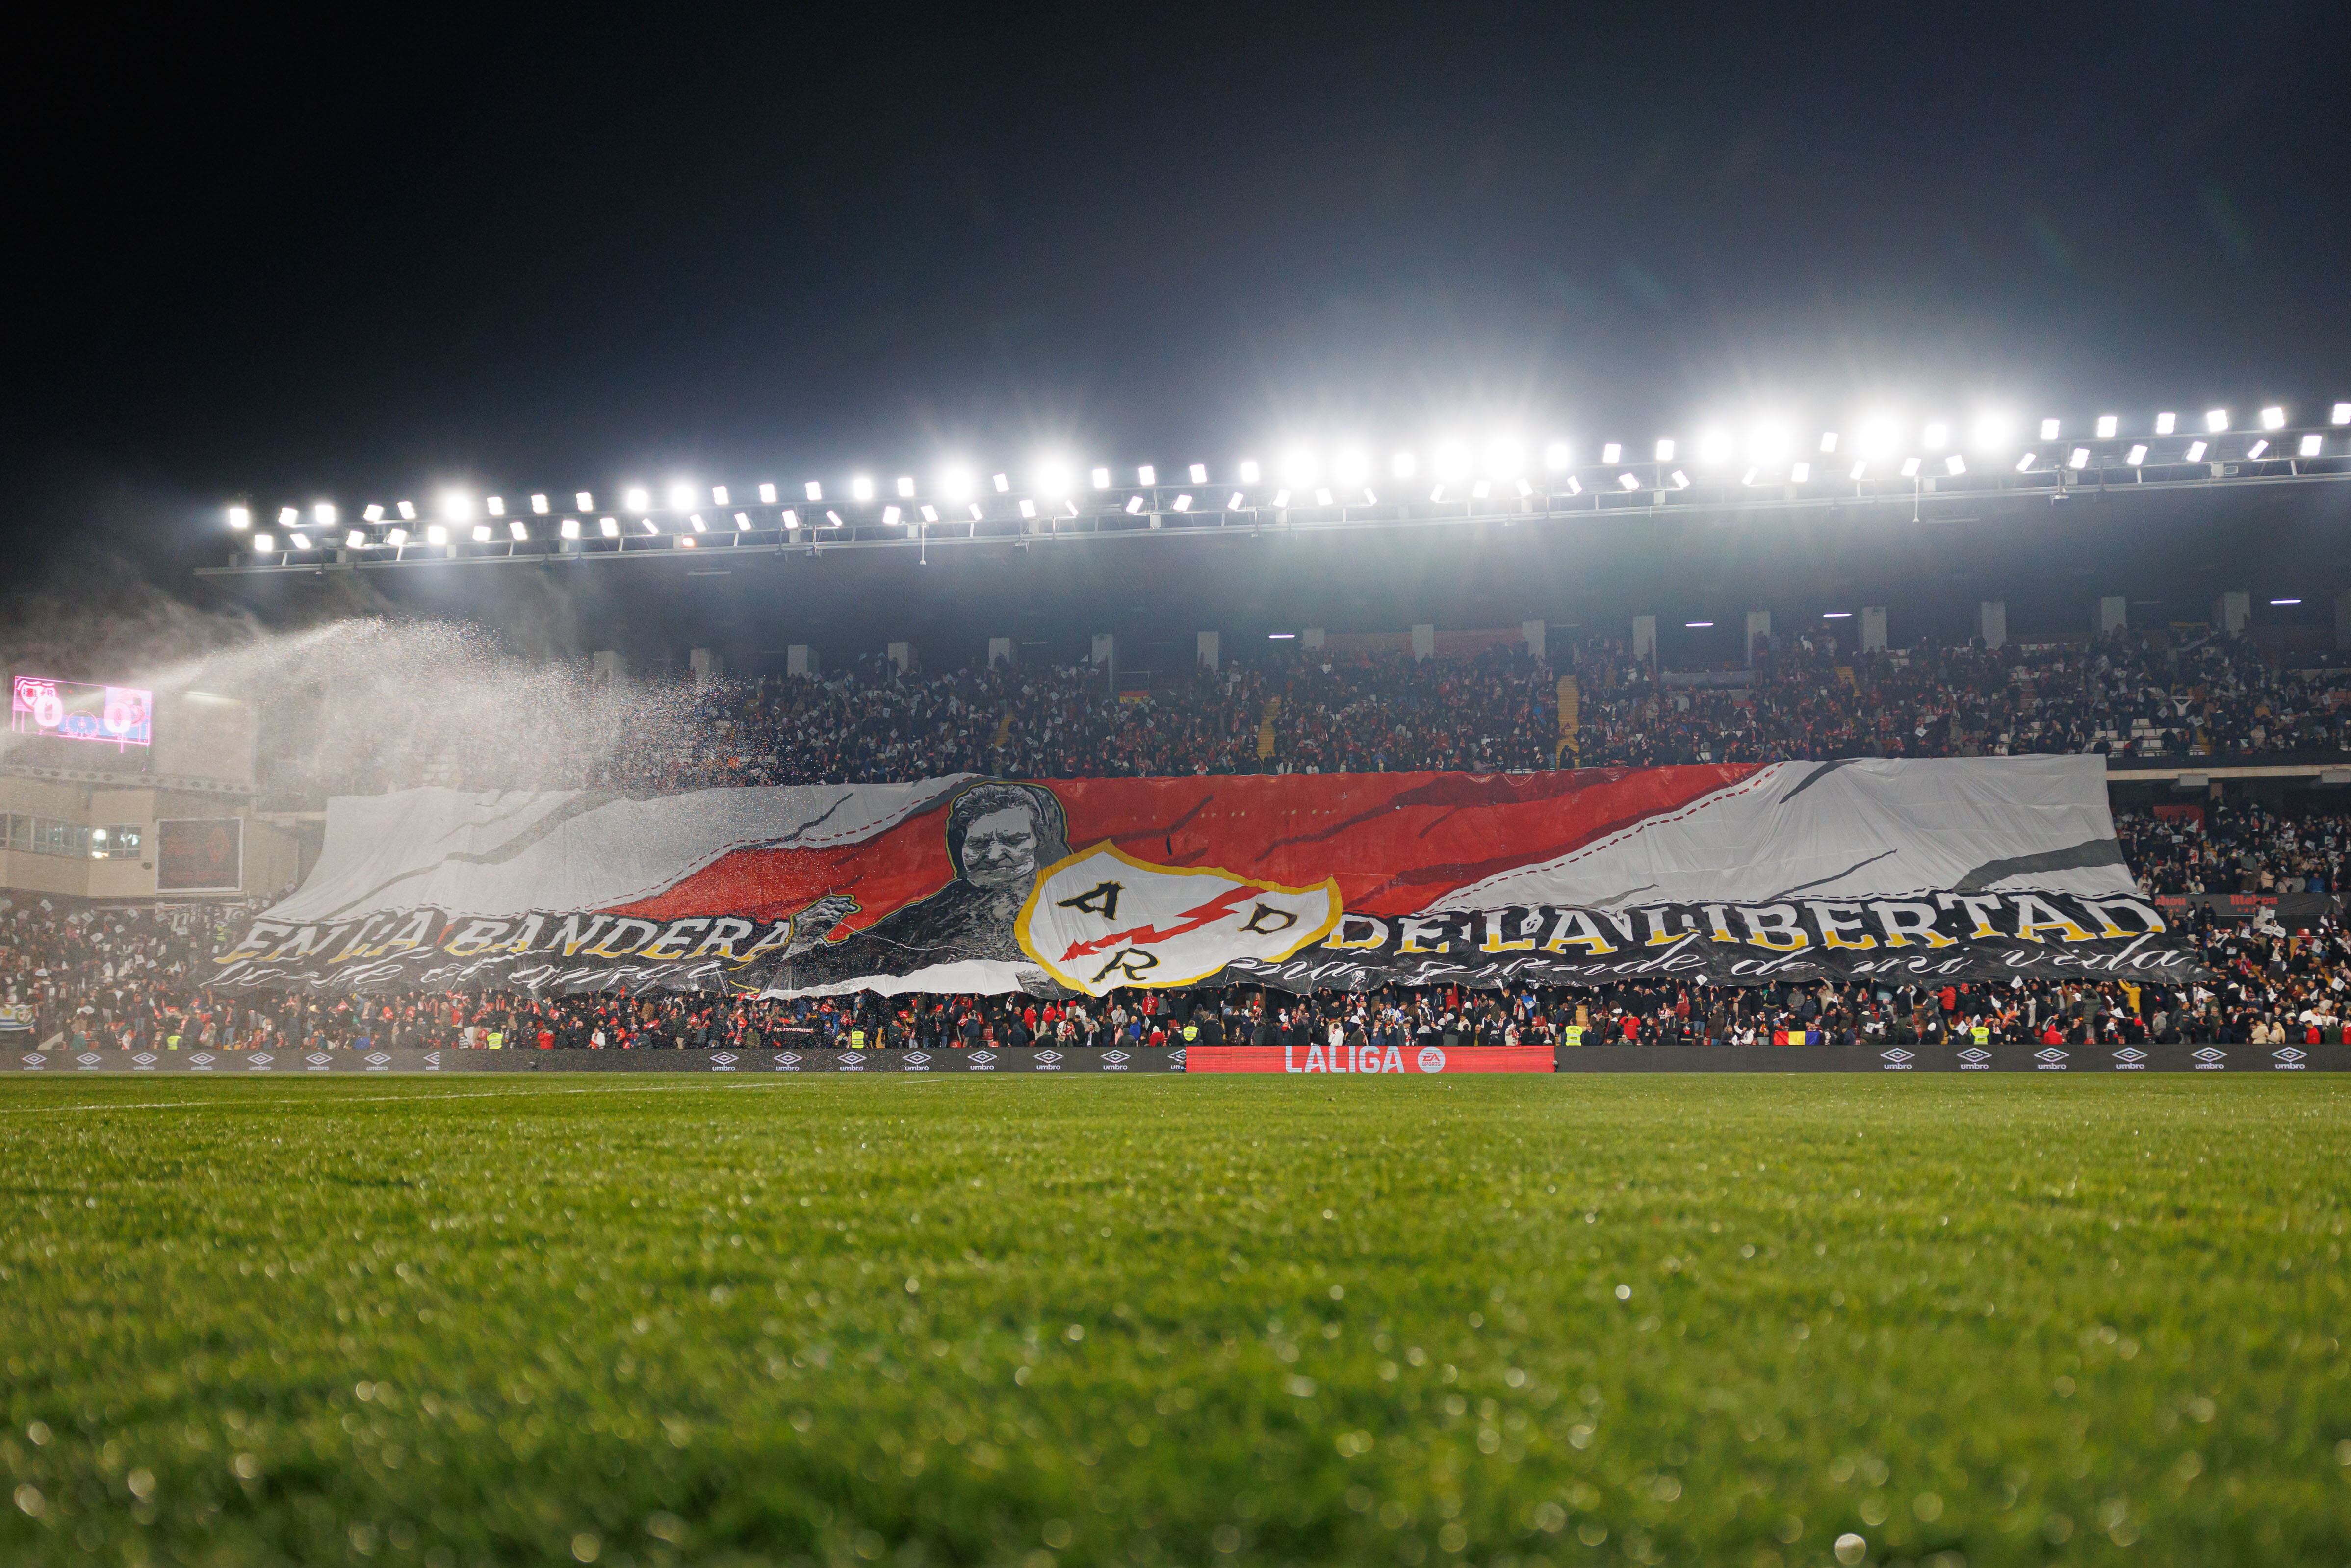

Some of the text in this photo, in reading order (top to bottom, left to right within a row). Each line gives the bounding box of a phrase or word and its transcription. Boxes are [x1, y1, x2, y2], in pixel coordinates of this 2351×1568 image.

[34, 697, 62, 727] 0
[104, 703, 131, 733] 0
[1056, 880, 1125, 920] A
[2230, 894, 2279, 906] Mahou
[213, 920, 352, 964] EN
[444, 912, 791, 962] BANDERA
[1321, 914, 1472, 956] DE
[1479, 906, 1618, 955] LA
[1638, 892, 2167, 952] LIBERTAD
[1237, 902, 1298, 935] D
[1090, 947, 1160, 984] R
[1731, 946, 1825, 976] de
[2001, 933, 2192, 971] vida
[1286, 1046, 1404, 1073] LALIGA
[1422, 1052, 1440, 1061] EA
